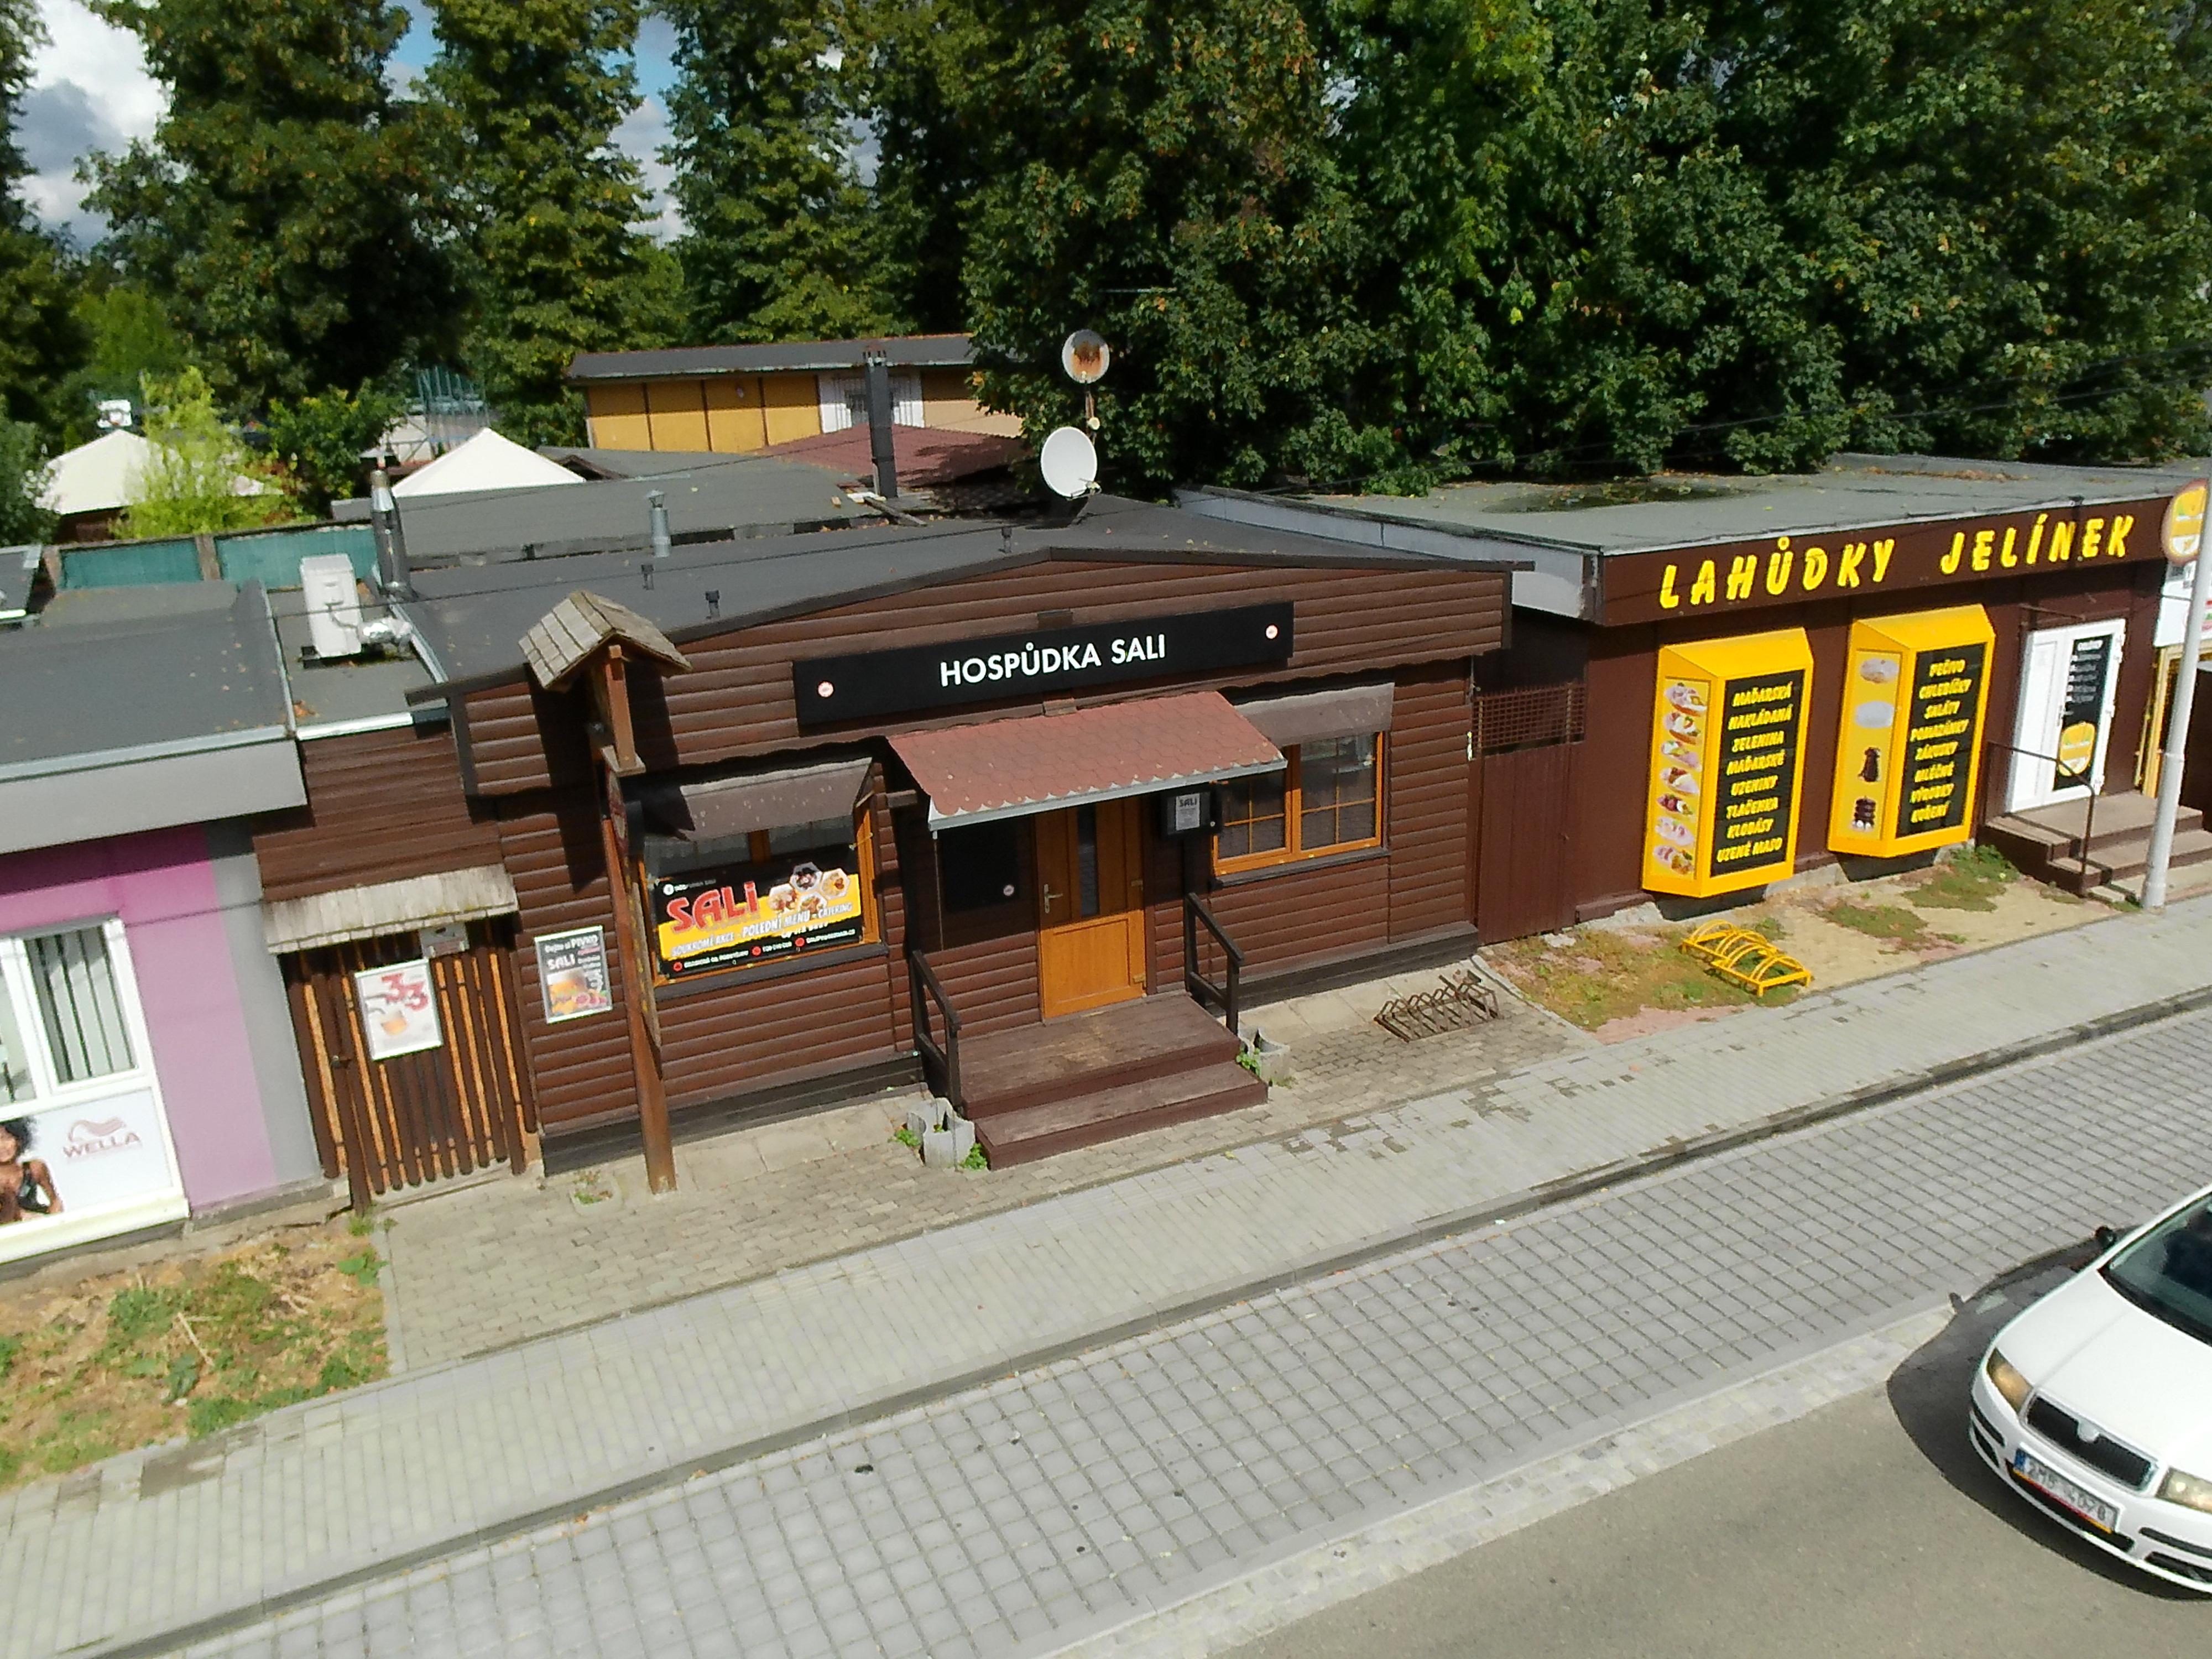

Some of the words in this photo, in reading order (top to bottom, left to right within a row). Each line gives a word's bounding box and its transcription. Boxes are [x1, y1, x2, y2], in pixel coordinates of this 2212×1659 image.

[1658, 535, 1895, 609] LAHŮDKY
[1940, 512, 2136, 575] JELÍNEK
[940, 641, 1101, 687] HOSPŮDKA
[1110, 634, 1166, 665] SALI
[1929, 659, 1965, 677] PEČIVO
[1732, 681, 1793, 707] MAĎARSKÁ
[1728, 703, 1793, 731] NAKLÁDANÁ
[1924, 700, 1960, 719] SALÁTY
[1731, 731, 1785, 753] ZELENINA
[1726, 749, 1786, 775] MAĎARSKÉ
[1730, 775, 1778, 796] UZENINY
[1726, 797, 1778, 820] TLAČENKA
[1726, 817, 1774, 839] KLOBÁSY
[1717, 840, 1752, 863] UZENÉ
[1751, 837, 1783, 855] MASO
[742, 915, 782, 938] POLEDNÍ
[783, 910, 811, 926] MENU
[817, 902, 853, 919] CATERING
[63, 1132, 143, 1157] WELLA
